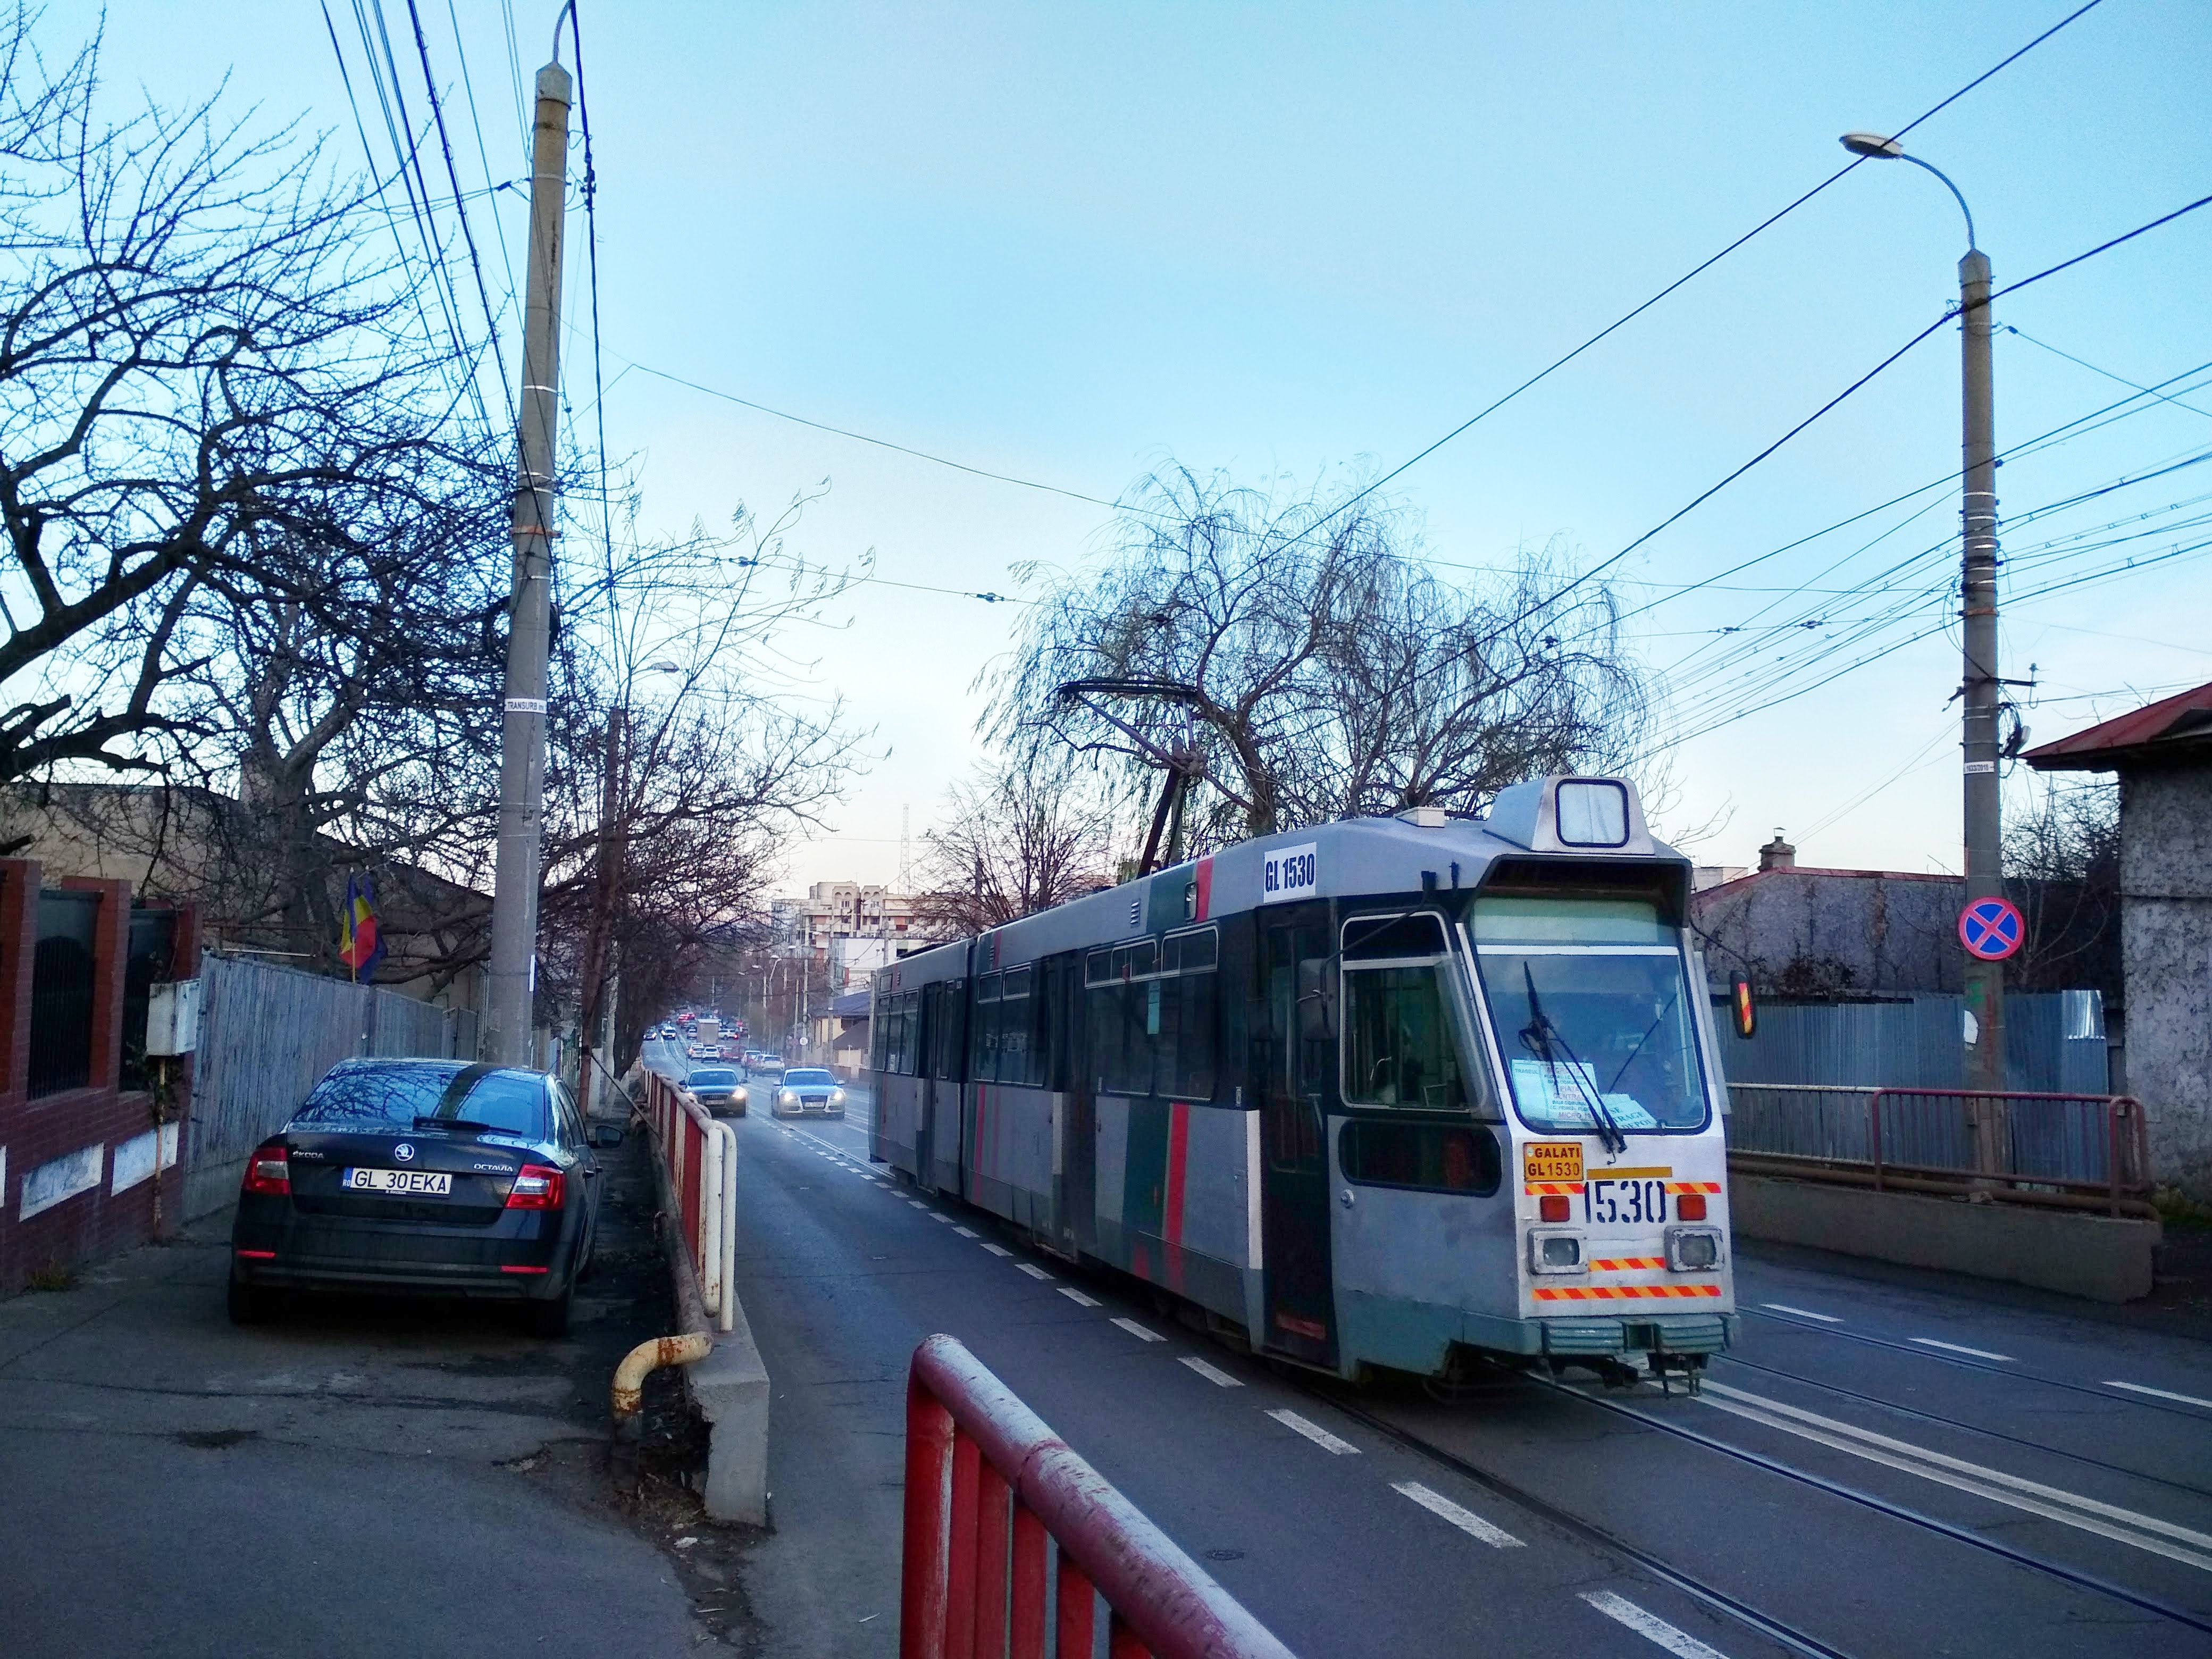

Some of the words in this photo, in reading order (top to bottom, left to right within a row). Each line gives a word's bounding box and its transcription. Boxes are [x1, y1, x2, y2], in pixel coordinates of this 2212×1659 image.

[507, 701, 537, 710] TRANSURB
[1266, 860, 1279, 892] GL
[1283, 853, 1314, 889] 1530
[1535, 1147, 1580, 1158] GALATI
[473, 1163, 513, 1172] OCTAVIA
[355, 1171, 378, 1187] GL
[1584, 1180, 1666, 1224] 1530
